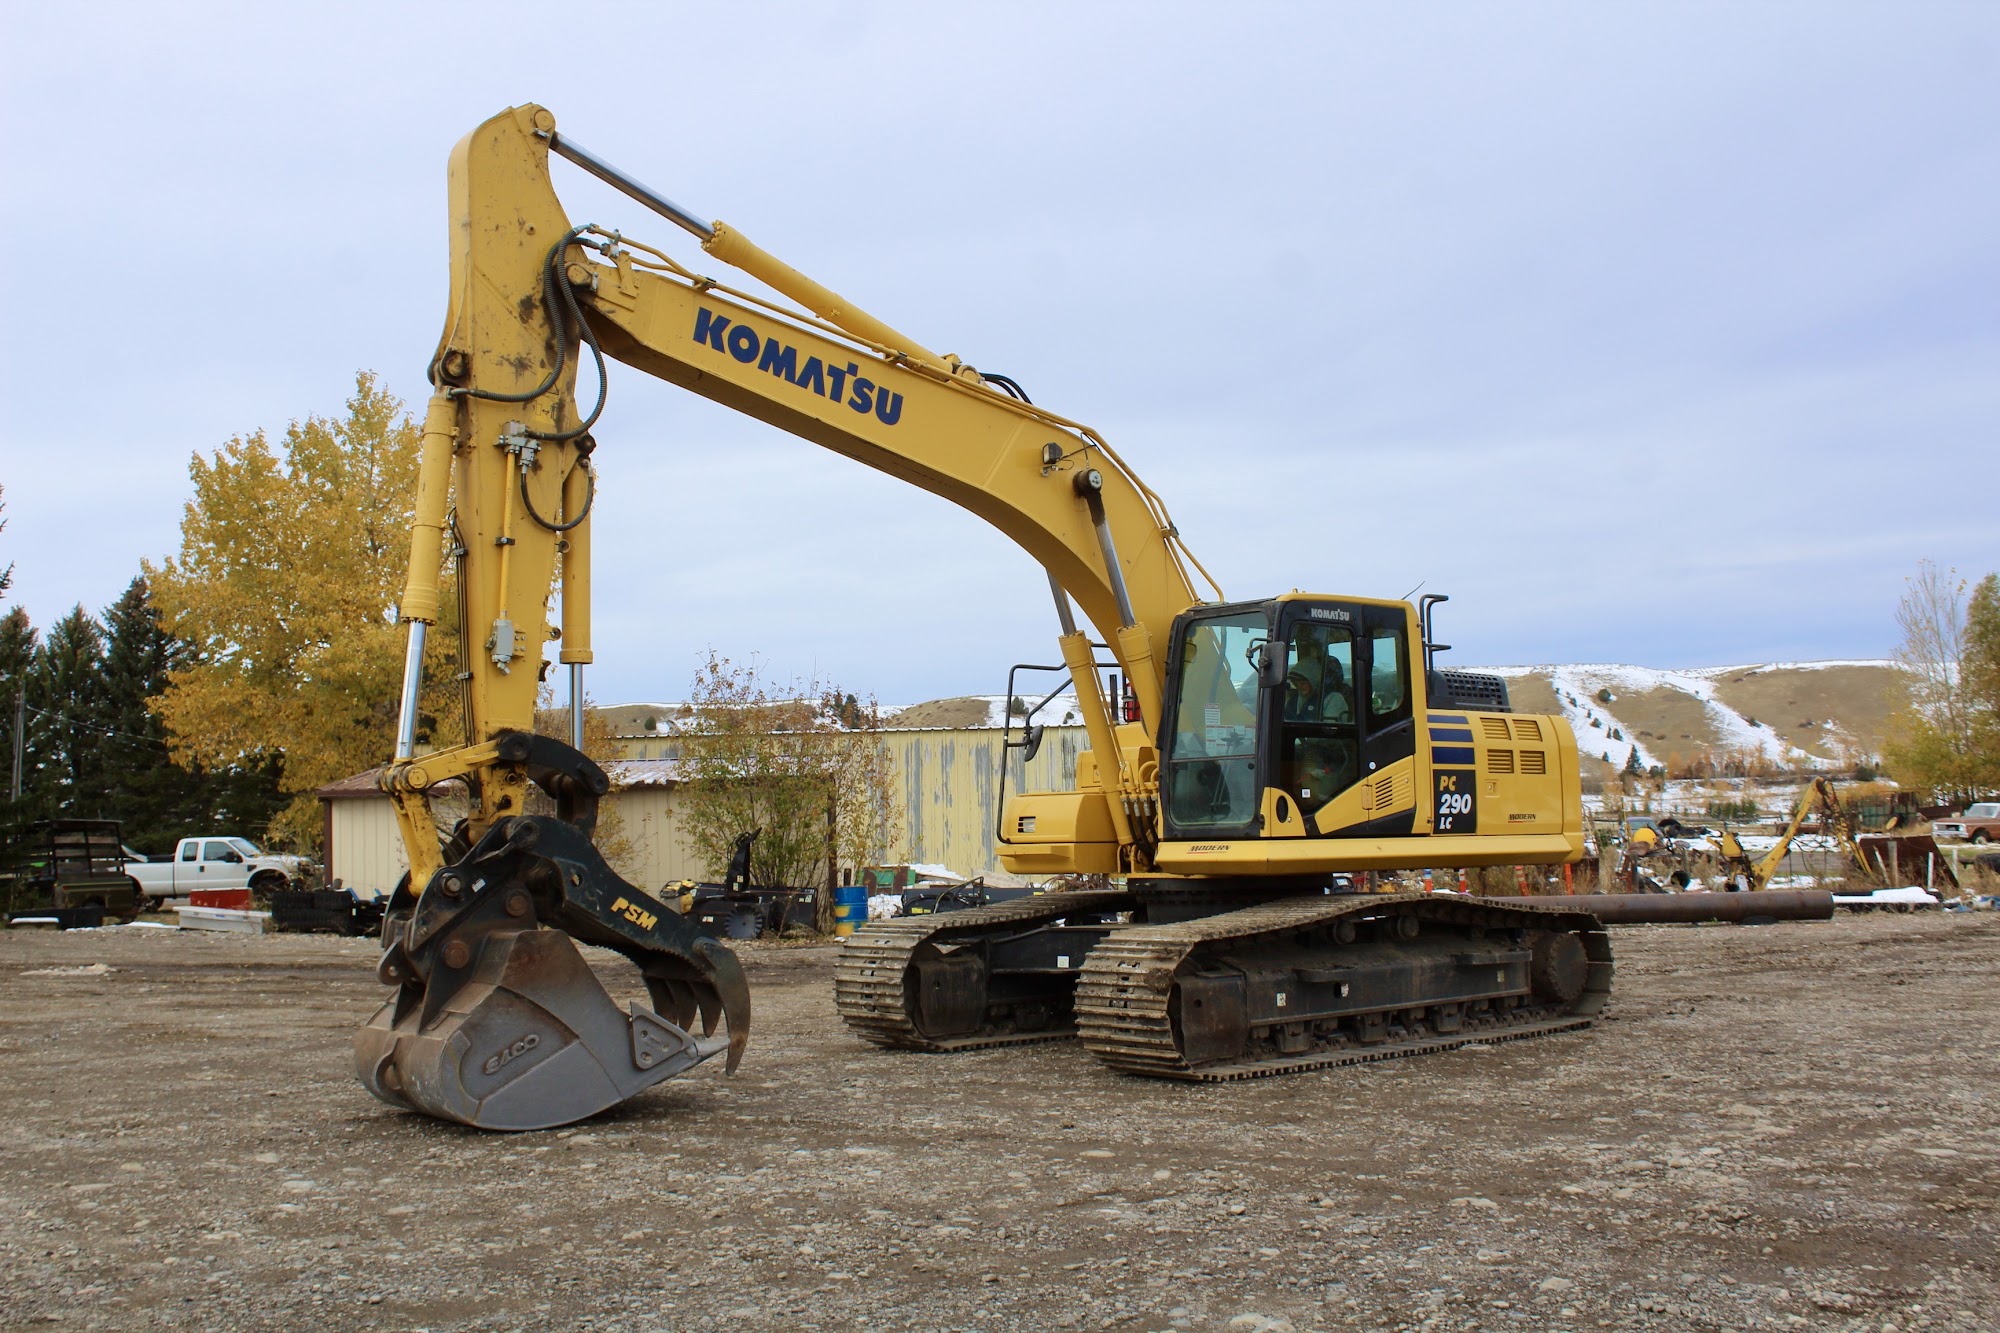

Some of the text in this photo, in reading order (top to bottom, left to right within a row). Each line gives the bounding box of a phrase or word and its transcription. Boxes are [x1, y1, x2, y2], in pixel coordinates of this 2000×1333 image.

[692, 306, 904, 426] KOMATSU
[1311, 608, 1350, 622] KOMATSU
[1440, 776, 1457, 791] PC
[1440, 793, 1472, 814] 290
[1439, 817, 1453, 830] LC
[1508, 813, 1536, 821] MODERN
[610, 896, 658, 931] PSM
